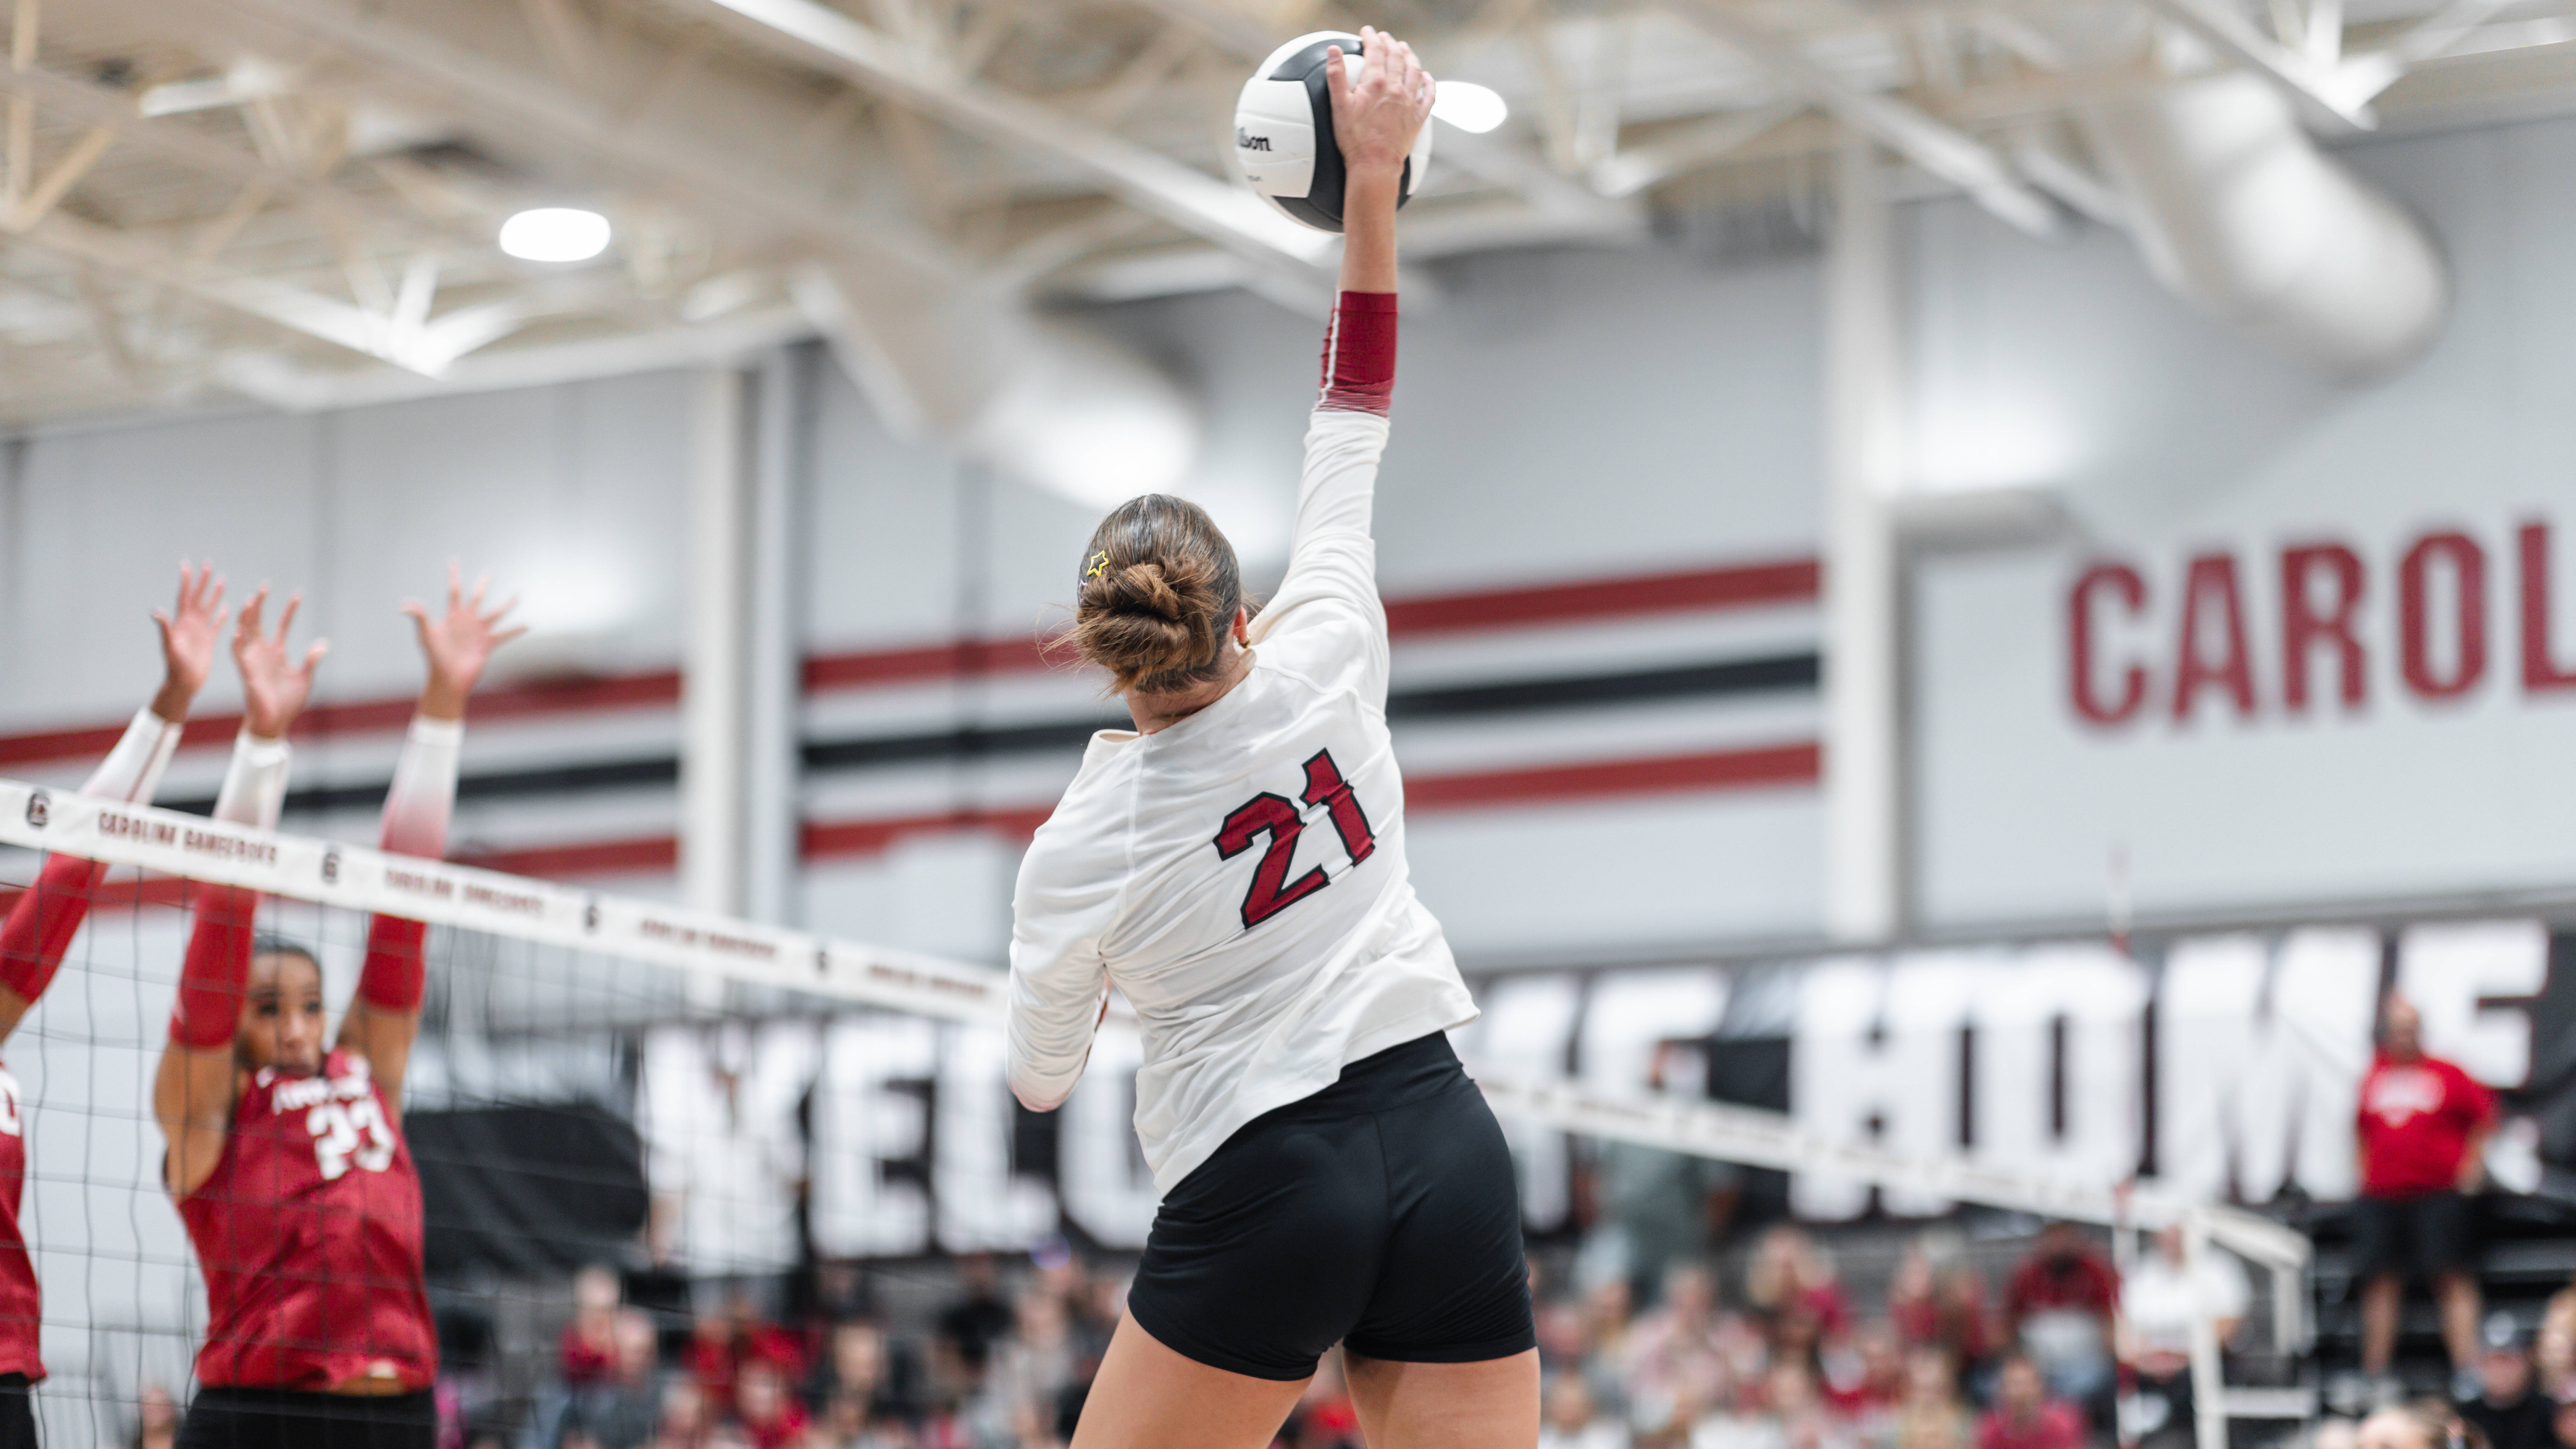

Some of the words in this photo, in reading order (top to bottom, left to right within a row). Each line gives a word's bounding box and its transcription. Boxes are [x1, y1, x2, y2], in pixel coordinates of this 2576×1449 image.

[2069, 522, 2576, 724] CAROL
[1212, 747, 1376, 930] 21
[306, 1097, 396, 1180] 23
[1789, 917, 2548, 1222] HOME
